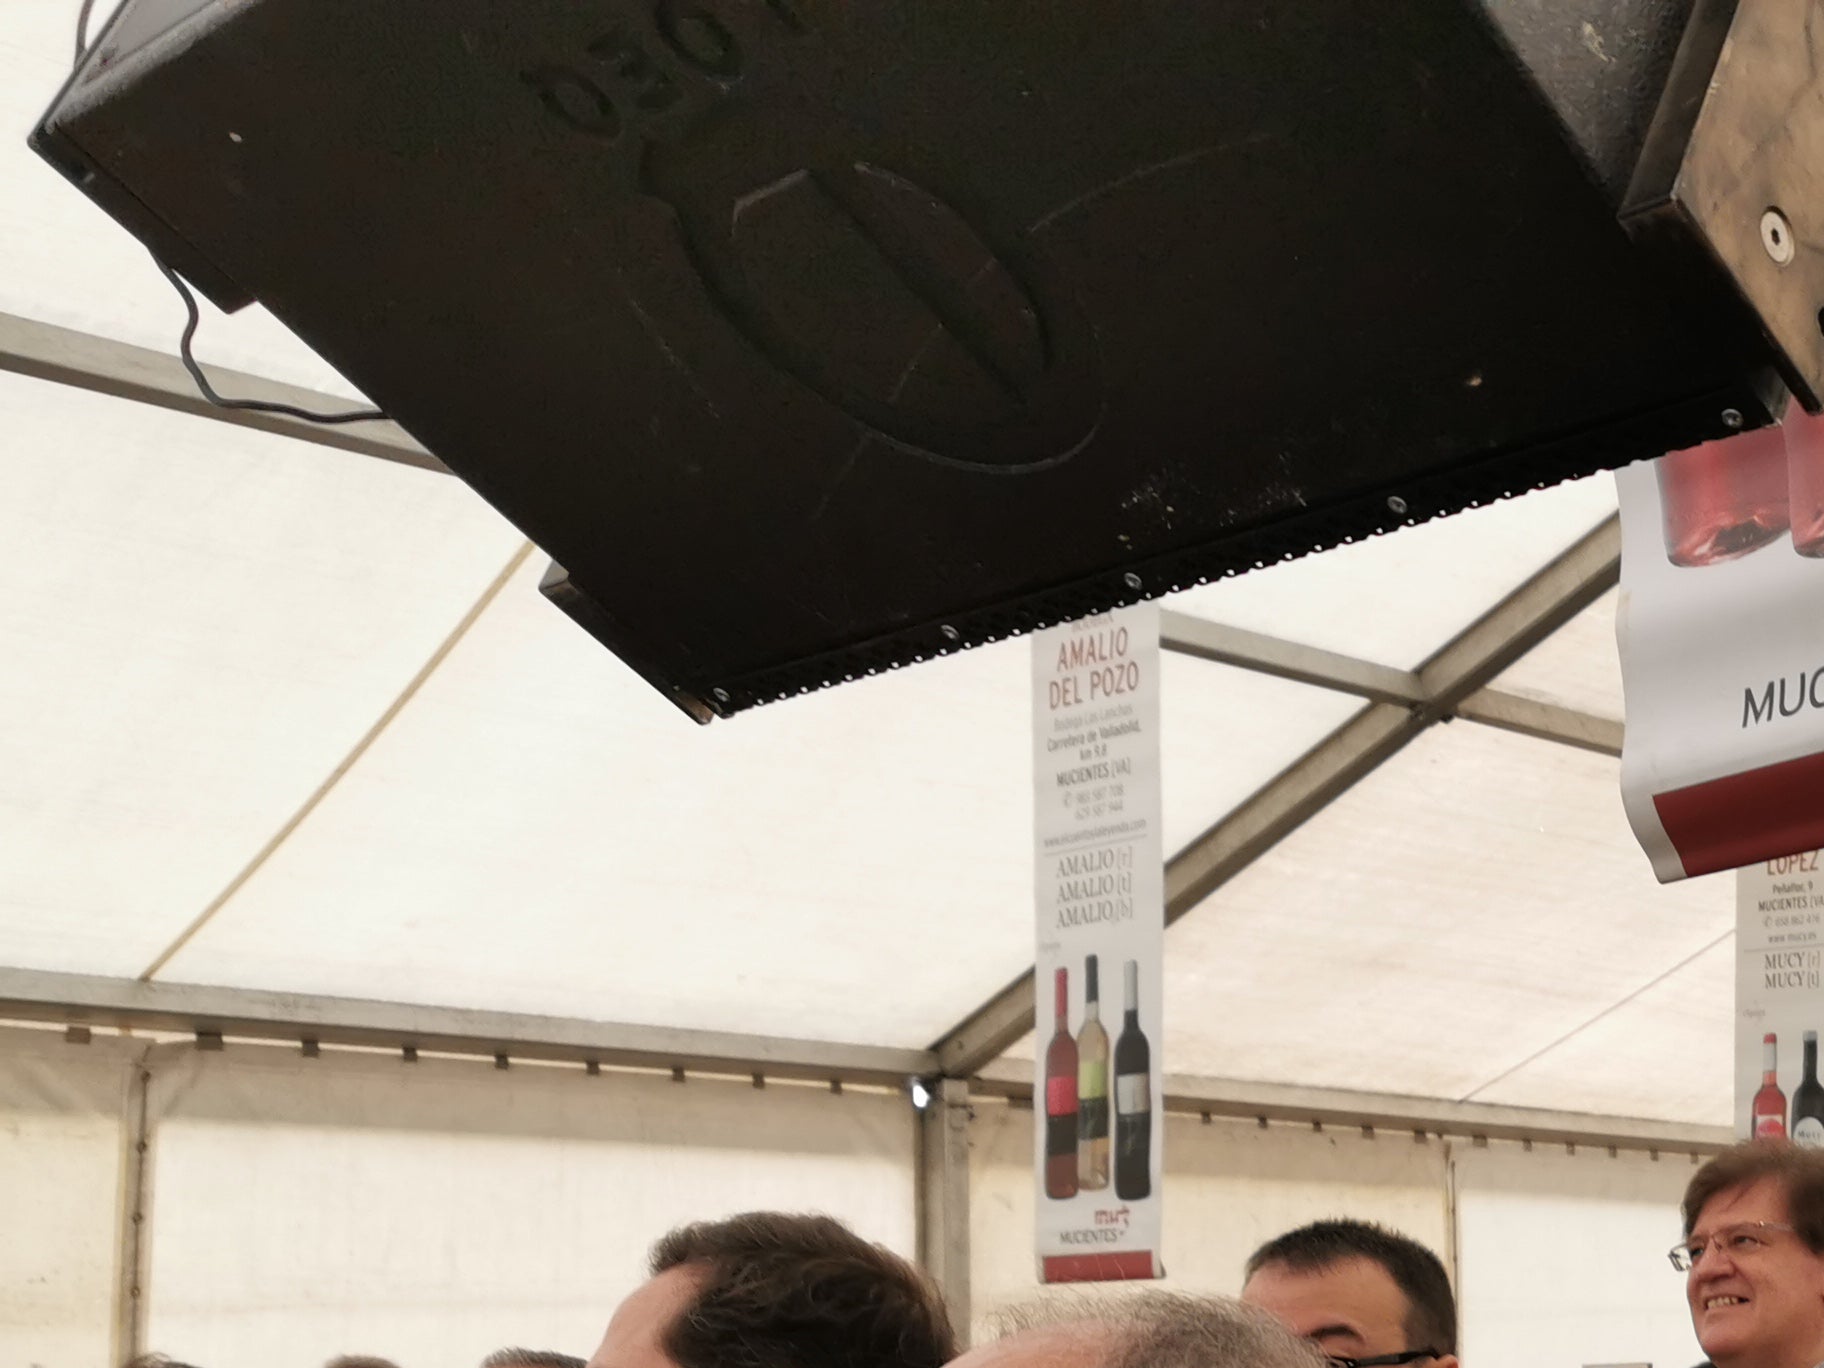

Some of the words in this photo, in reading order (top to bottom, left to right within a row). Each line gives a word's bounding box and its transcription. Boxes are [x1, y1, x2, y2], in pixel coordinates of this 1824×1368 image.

[1057, 626, 1128, 672] AMALIO
[1049, 675, 1083, 710] DEL
[1090, 660, 1139, 700] POZO
[1056, 849, 1114, 878] AMALIO
[1056, 874, 1114, 904] AMALIO
[1056, 900, 1113, 928] AMALIO
[1765, 951, 1805, 970] MUCY
[1765, 970, 1805, 989] MUCY
[1060, 1229, 1118, 1244] MUCIENTES
